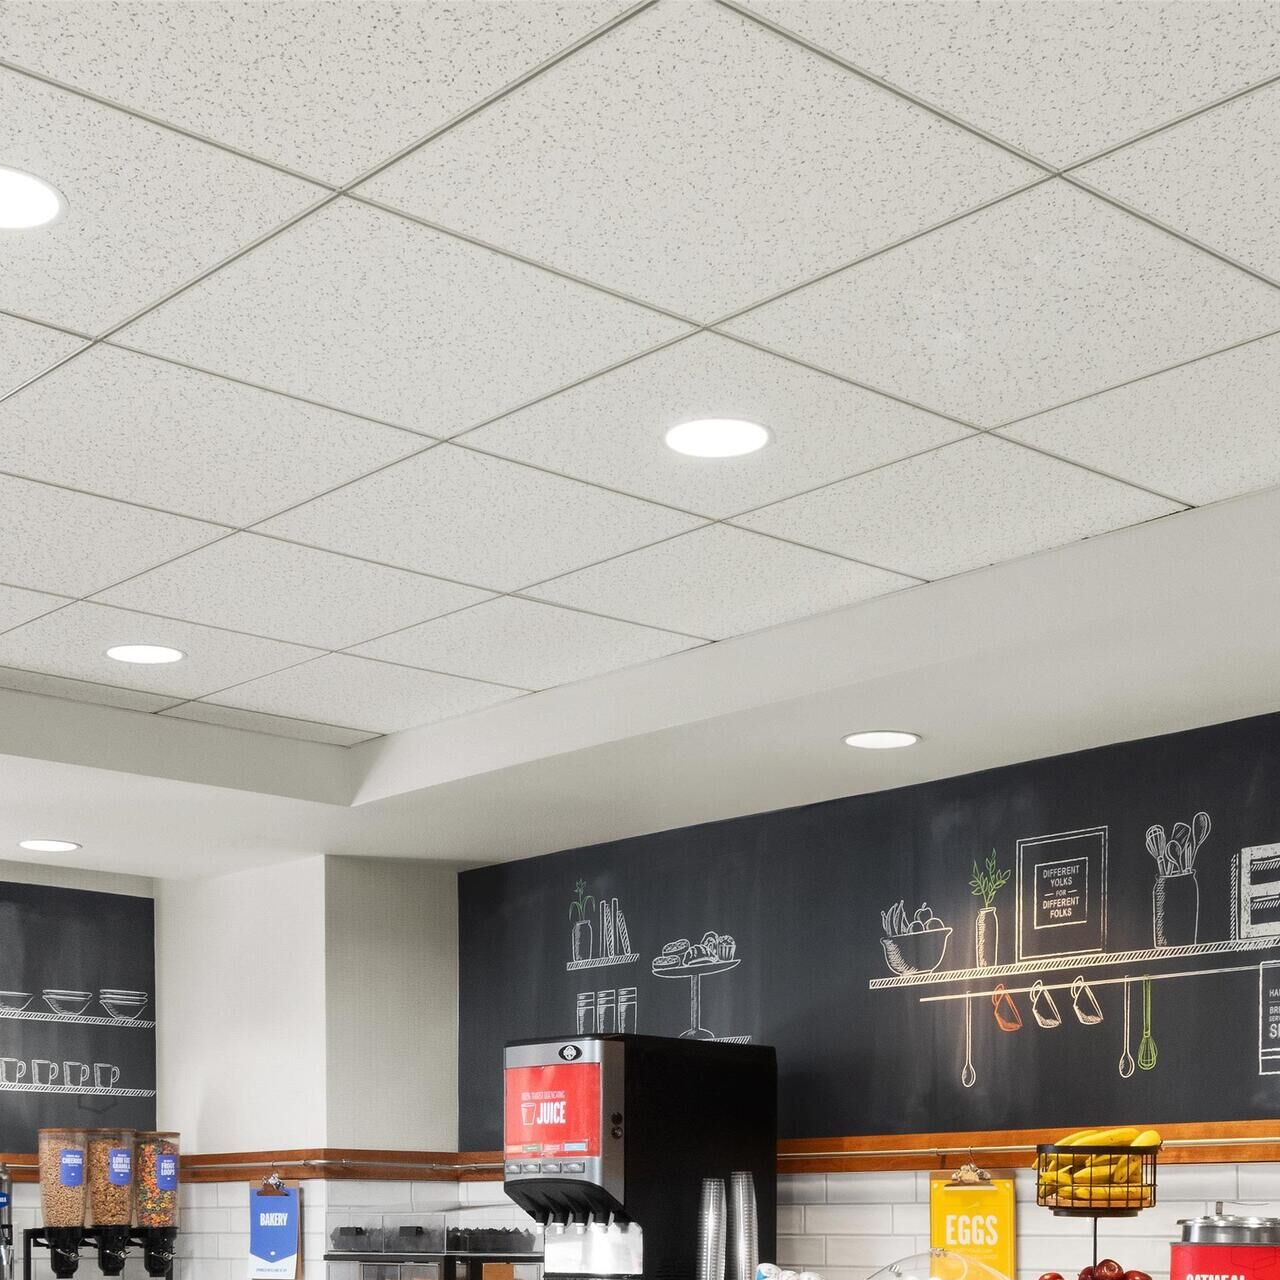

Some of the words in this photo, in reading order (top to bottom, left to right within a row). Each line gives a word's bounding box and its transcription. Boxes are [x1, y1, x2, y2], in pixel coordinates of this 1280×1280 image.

[1043, 865, 1080, 879] DIFFERENT
[1050, 876, 1073, 887] YOLKS
[1056, 889, 1067, 897] FOR
[1043, 896, 1080, 909] DIFFERENT
[1050, 907, 1072, 919] FOLKS
[537, 1101, 566, 1124] JUICE
[260, 1213, 288, 1226] BAKERY
[945, 1214, 999, 1246] EGGS
